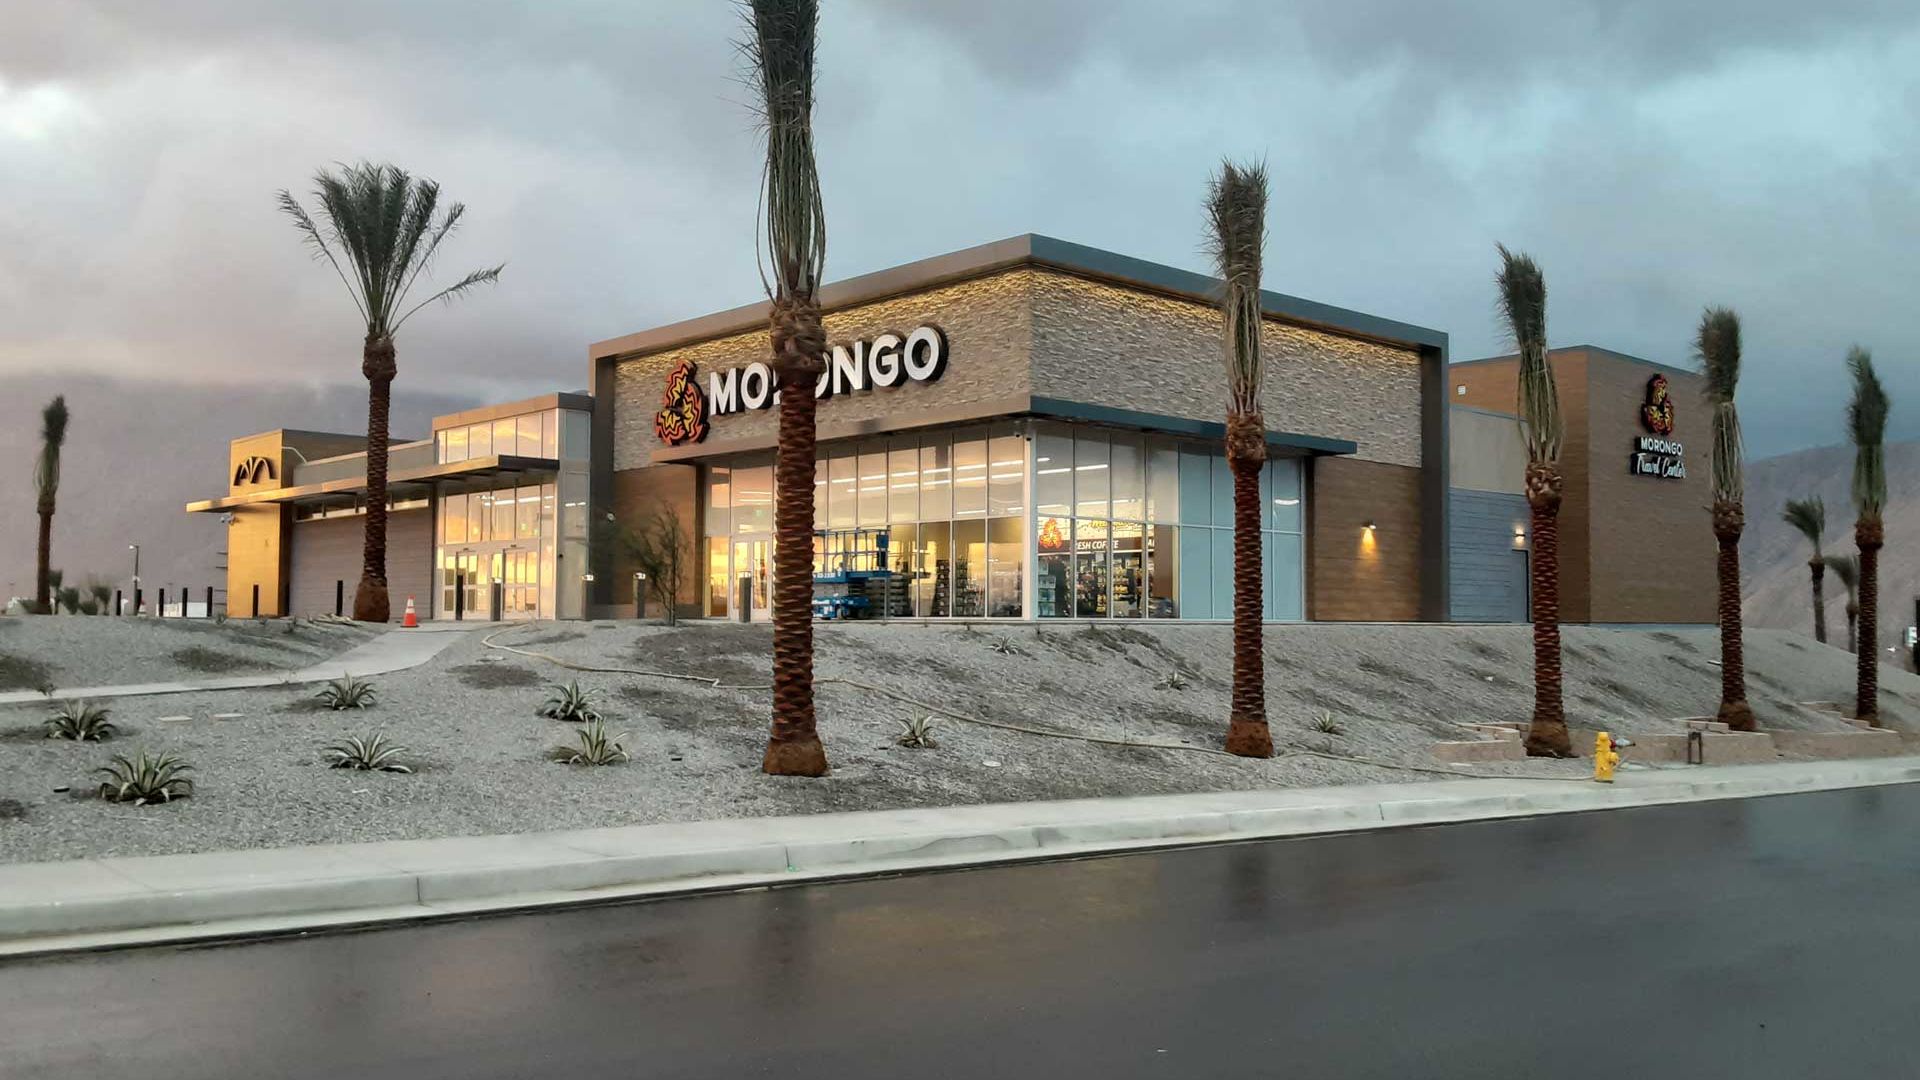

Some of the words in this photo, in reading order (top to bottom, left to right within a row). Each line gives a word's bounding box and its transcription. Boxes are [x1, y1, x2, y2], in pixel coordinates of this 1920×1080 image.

[709, 325, 945, 416] MONGO
[1640, 436, 1683, 456] MORONGO
[1636, 452, 1661, 475] Travel
[1662, 456, 1686, 479] Center
[1092, 540, 1119, 550] COFE
